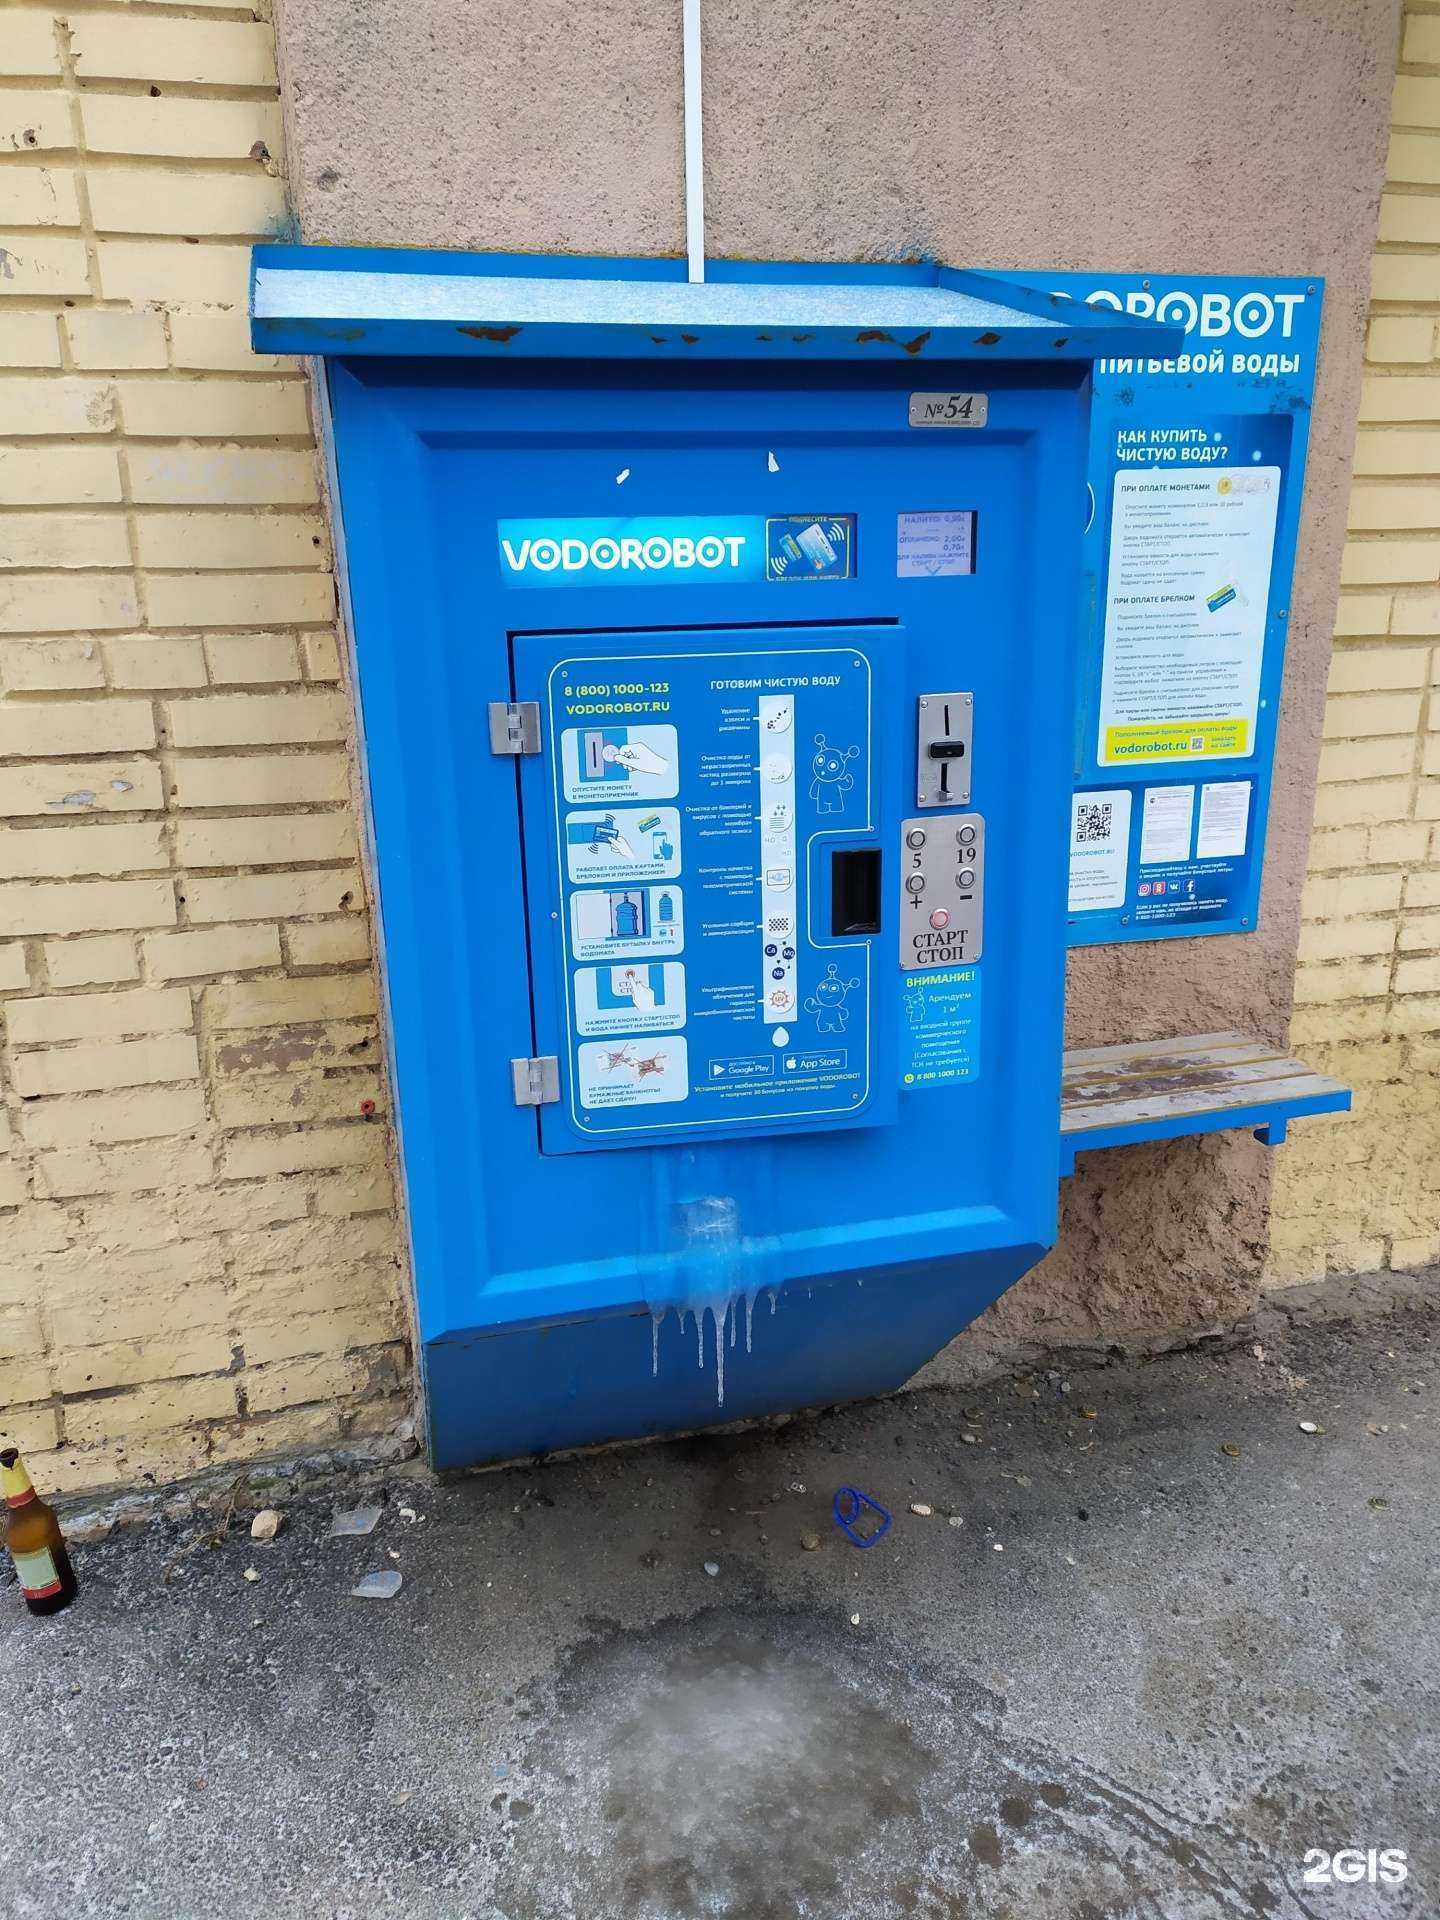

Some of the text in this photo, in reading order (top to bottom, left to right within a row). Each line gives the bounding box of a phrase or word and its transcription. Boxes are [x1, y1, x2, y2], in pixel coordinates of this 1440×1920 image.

[1232, 353, 1299, 376] ВОДЫ
[1118, 429, 1207, 443] КАК КУПИТЬ
[1117, 446, 1228, 462] ЧИСТУЮ ВОДУ?
[501, 535, 746, 571] VODOROBOT
[1113, 595, 1195, 605] ПРИ ОПЛАТЕ БРЕЛКОМ
[710, 676, 841, 689] ГОТОВИМ ЧИСТУЮ ВОДУ
[564, 683, 669, 697] 8 (800) 1000-123
[566, 702, 669, 715] VODOROBOT.RU
[1114, 741, 1187, 754] vodorobot.ru
[913, 848, 976, 868] 5 19
[913, 930, 968, 948] СТАРТ
[917, 947, 963, 963] СТОП
[907, 971, 975, 987] ВНИМАНИЕ!
[929, 993, 971, 1002] Арендуем
[585, 1018, 616, 1026] НАЖМИТЕ
[729, 1065, 753, 1074] Google
[800, 1058, 840, 1068] App Store
[598, 1083, 634, 1091] ПРИНИМАЕТ
